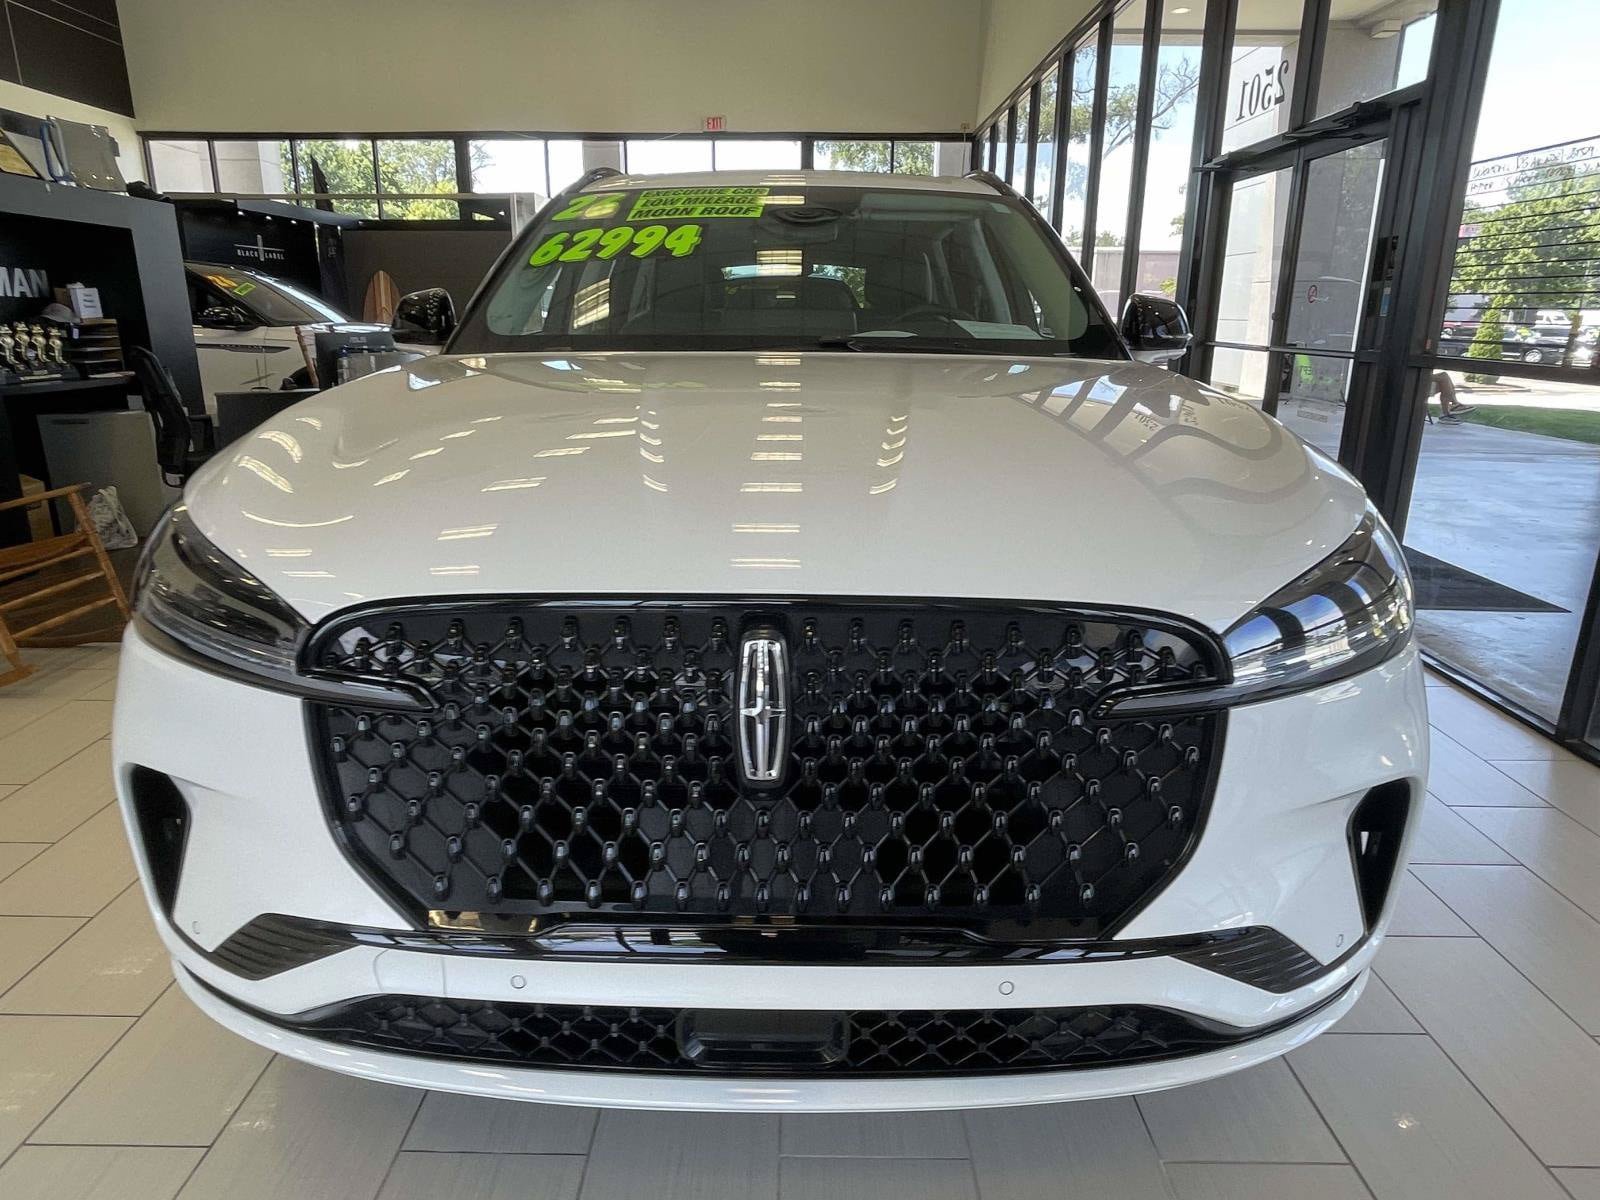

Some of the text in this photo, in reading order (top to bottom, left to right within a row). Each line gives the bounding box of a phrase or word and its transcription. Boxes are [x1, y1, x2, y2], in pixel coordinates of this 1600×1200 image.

[706, 116, 723, 129] EXIT
[641, 188, 729, 197] EXECUTIVE
[640, 196, 759, 207] LOW MILEAGE
[631, 206, 758, 219] MOON ROOF
[529, 224, 703, 268] 62994
[264, 252, 285, 260] LABEL
